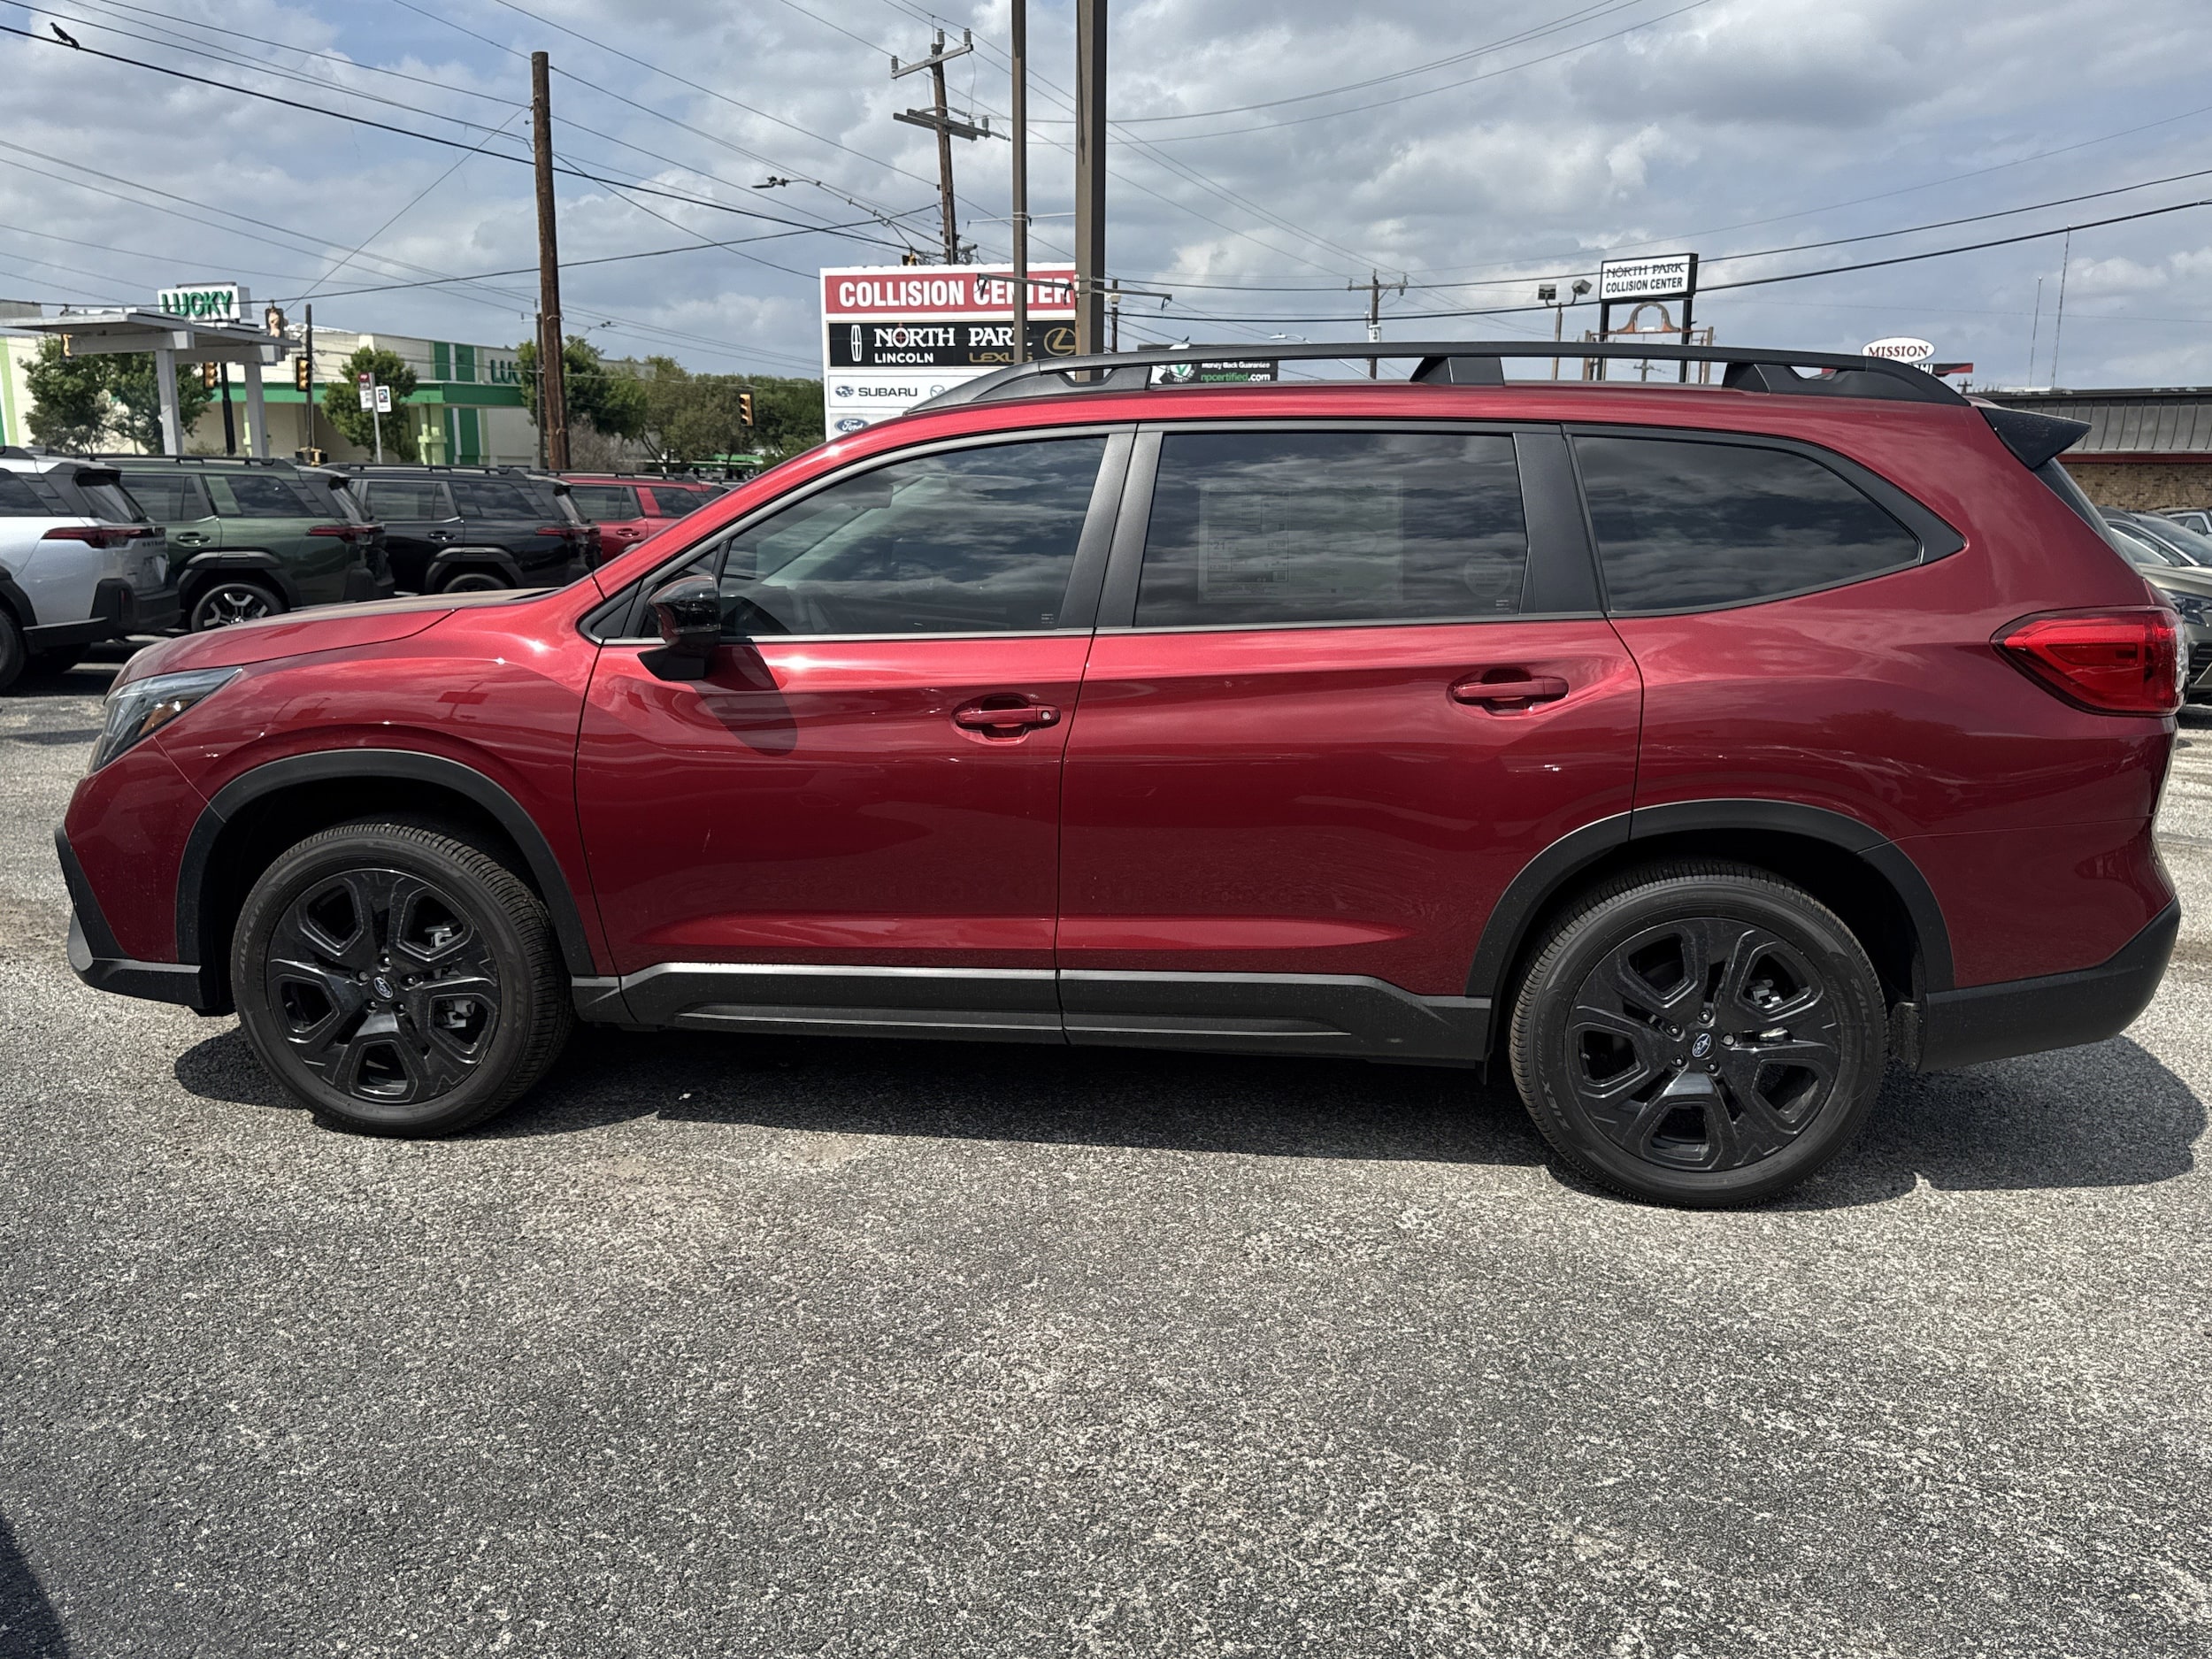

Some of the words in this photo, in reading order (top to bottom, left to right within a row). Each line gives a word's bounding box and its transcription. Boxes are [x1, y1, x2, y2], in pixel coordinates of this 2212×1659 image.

[1606, 265, 1647, 279] NORTH
[1652, 262, 1685, 274] PARK
[1606, 279, 1648, 293] COLLISION
[1650, 277, 1683, 289] CENTER
[839, 280, 964, 307] COLLISION
[161, 290, 233, 316] LUCKY
[874, 326, 956, 349] NORTH
[968, 326, 1033, 347] PAR
[874, 352, 933, 364] LINCOLN
[1868, 345, 1929, 357] MISSION
[1201, 372, 1271, 382] npcertified.com
[858, 387, 918, 397] SUBARU
